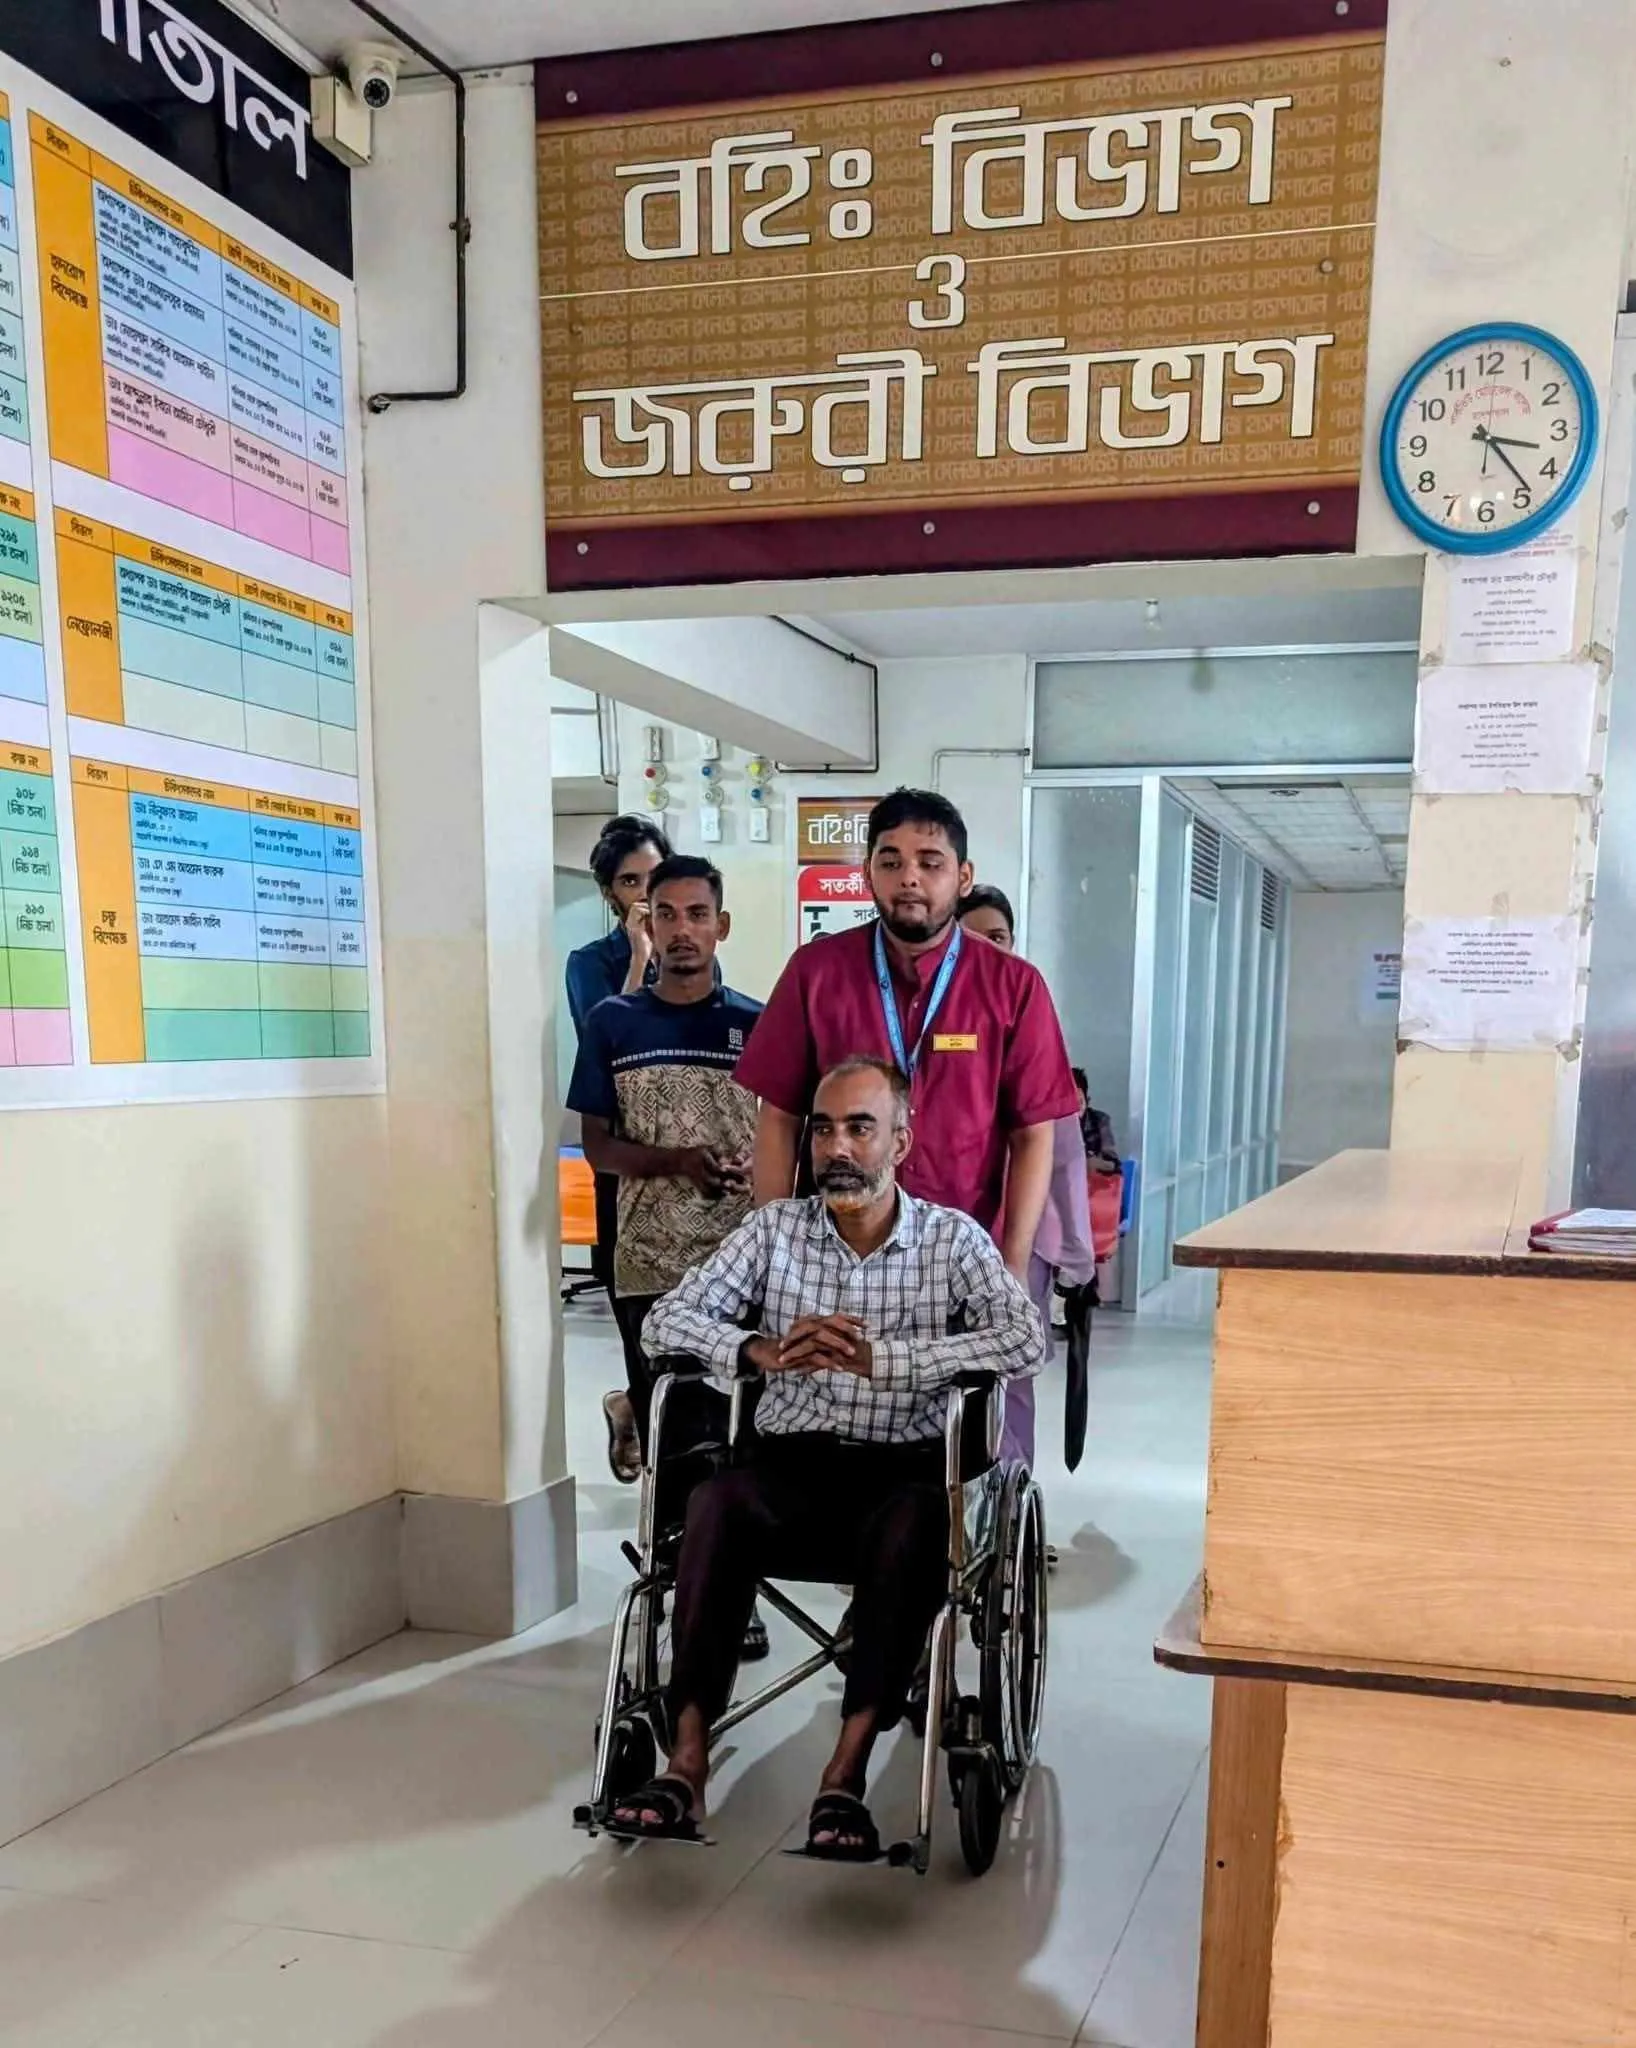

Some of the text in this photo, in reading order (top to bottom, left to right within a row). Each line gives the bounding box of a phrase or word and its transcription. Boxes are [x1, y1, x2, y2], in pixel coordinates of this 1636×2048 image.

[615, 96, 1292, 261] বহিঃ বিভাগ
[908, 254, 966, 329] ও
[1475, 352, 1504, 376] 12
[1521, 358, 1530, 380] 1
[1445, 367, 1465, 391] 11
[1542, 382, 1560, 406] 2
[573, 334, 1335, 489] জরুরী বিভাগ
[1419, 398, 1445, 422] 10
[1550, 419, 1568, 441] 3
[1409, 435, 1427, 457] 9
[1539, 457, 1558, 479] 4
[1418, 471, 1435, 493] 8
[1443, 494, 1461, 517] 7
[1512, 488, 1531, 509] 5
[1477, 501, 1495, 522] 6
